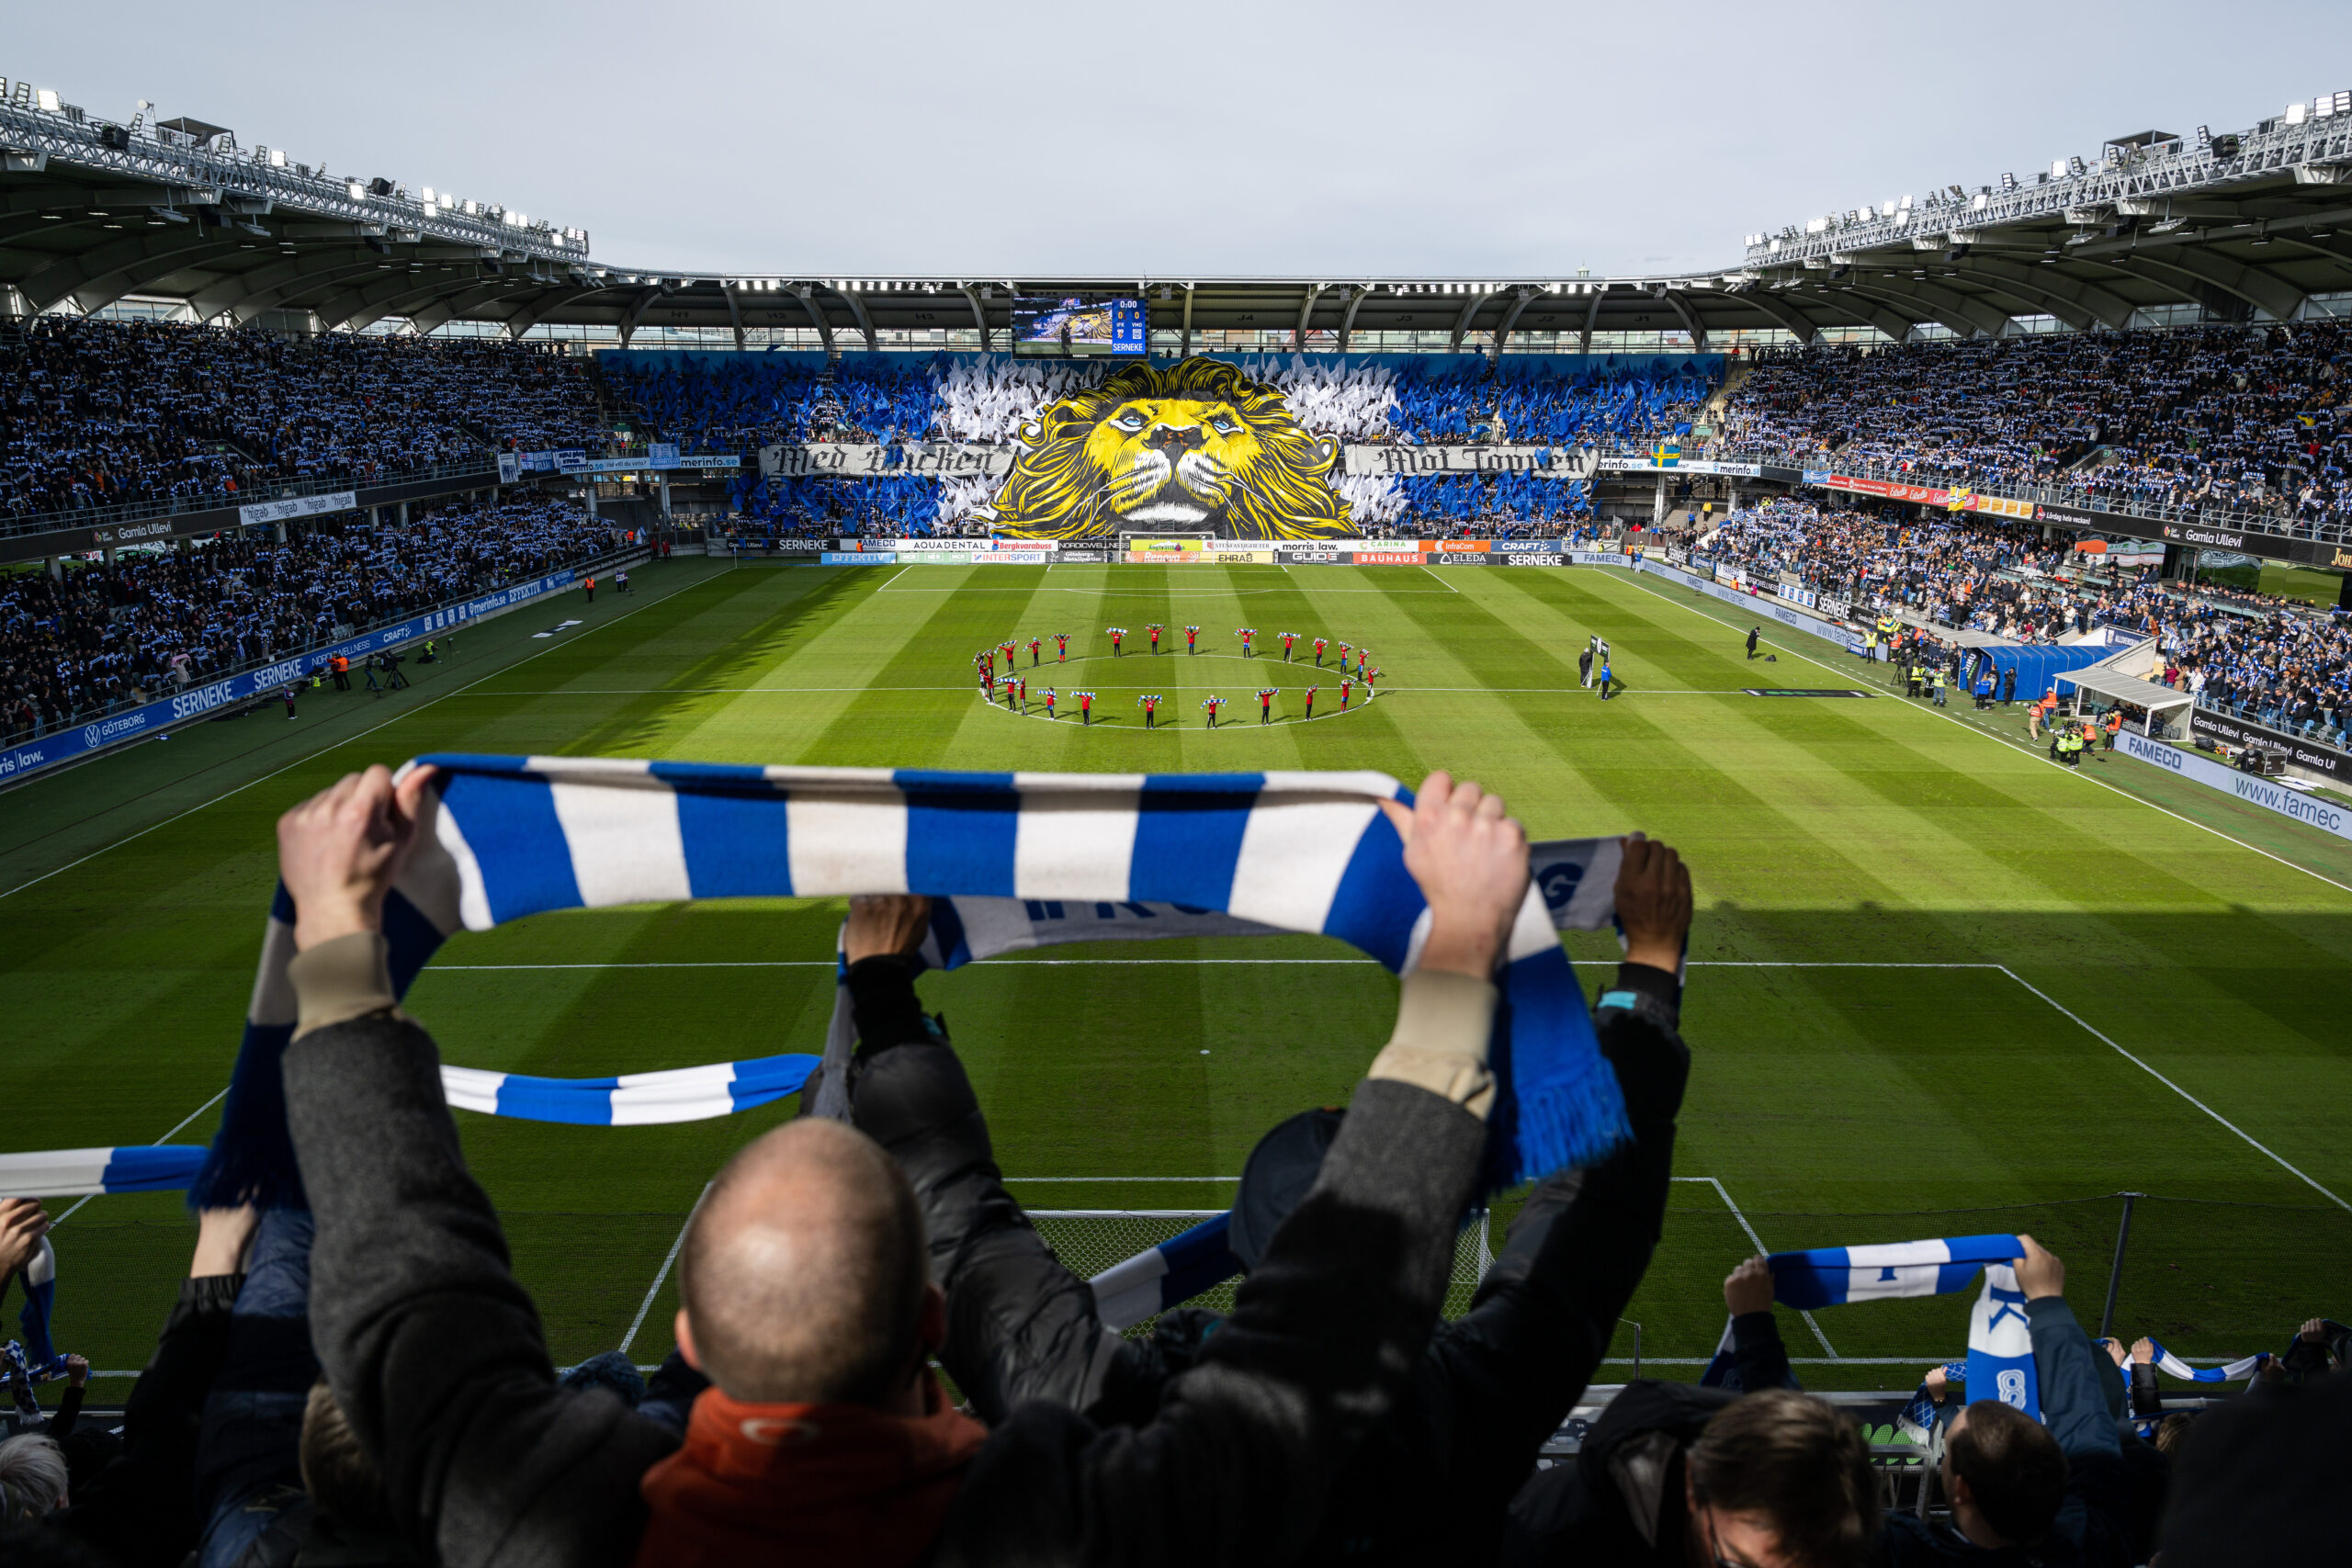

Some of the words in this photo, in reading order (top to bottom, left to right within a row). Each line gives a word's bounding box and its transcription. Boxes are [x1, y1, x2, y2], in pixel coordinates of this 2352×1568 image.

[1120, 300, 1137, 309] 0:00
[1117, 310, 1124, 320] 0
[1134, 310, 1140, 320] 0
[1113, 343, 1143, 352] SERNEKE
[681, 457, 738, 467] merinfo.se
[1374, 446, 1450, 472] Mot
[1598, 459, 1644, 469] erinfo.se
[1720, 466, 1759, 476] merinfo.se
[277, 502, 298, 517] higab
[334, 494, 353, 508] higab
[119, 525, 147, 539] Gamla
[148, 522, 172, 535] Ullevi
[779, 539, 828, 550] SERNEKE
[862, 539, 896, 547] AMECO
[913, 541, 986, 550] AQUADENTAL
[2186, 530, 2214, 544] Gamla
[2216, 534, 2243, 547] Ullevi
[1000, 542, 1052, 551] Bergkvarabuss
[1283, 543, 1314, 551] morris
[1318, 542, 1338, 551] law.
[1501, 542, 1539, 550] CRAFT
[831, 554, 884, 562] EFFEKTIV
[982, 554, 1041, 562] INTERSPORT
[1509, 555, 1564, 566] SERNEKE
[1584, 554, 1622, 563] FAMECO
[1668, 547, 1688, 564] SERNEKE
[1723, 565, 1740, 578] FAMECO
[1687, 576, 1703, 590] FAMECO
[509, 581, 541, 602] EFFEKTIV
[474, 596, 506, 614] merinfo.se
[1818, 596, 1851, 620] SERNEKE
[1775, 607, 1797, 625] FAMECO
[383, 628, 406, 642] CRAFT
[254, 659, 302, 690] SERNEKE
[172, 681, 233, 719] SERNEKE
[102, 714, 145, 736] GÖTEBORG
[2194, 716, 2216, 731] Gamla
[2217, 722, 2240, 739] Ullevi
[2296, 750, 2324, 766] Gamla
[18, 750, 44, 768] law.
[2129, 738, 2182, 770] FAMECO
[2236, 777, 2341, 830] www.famec
